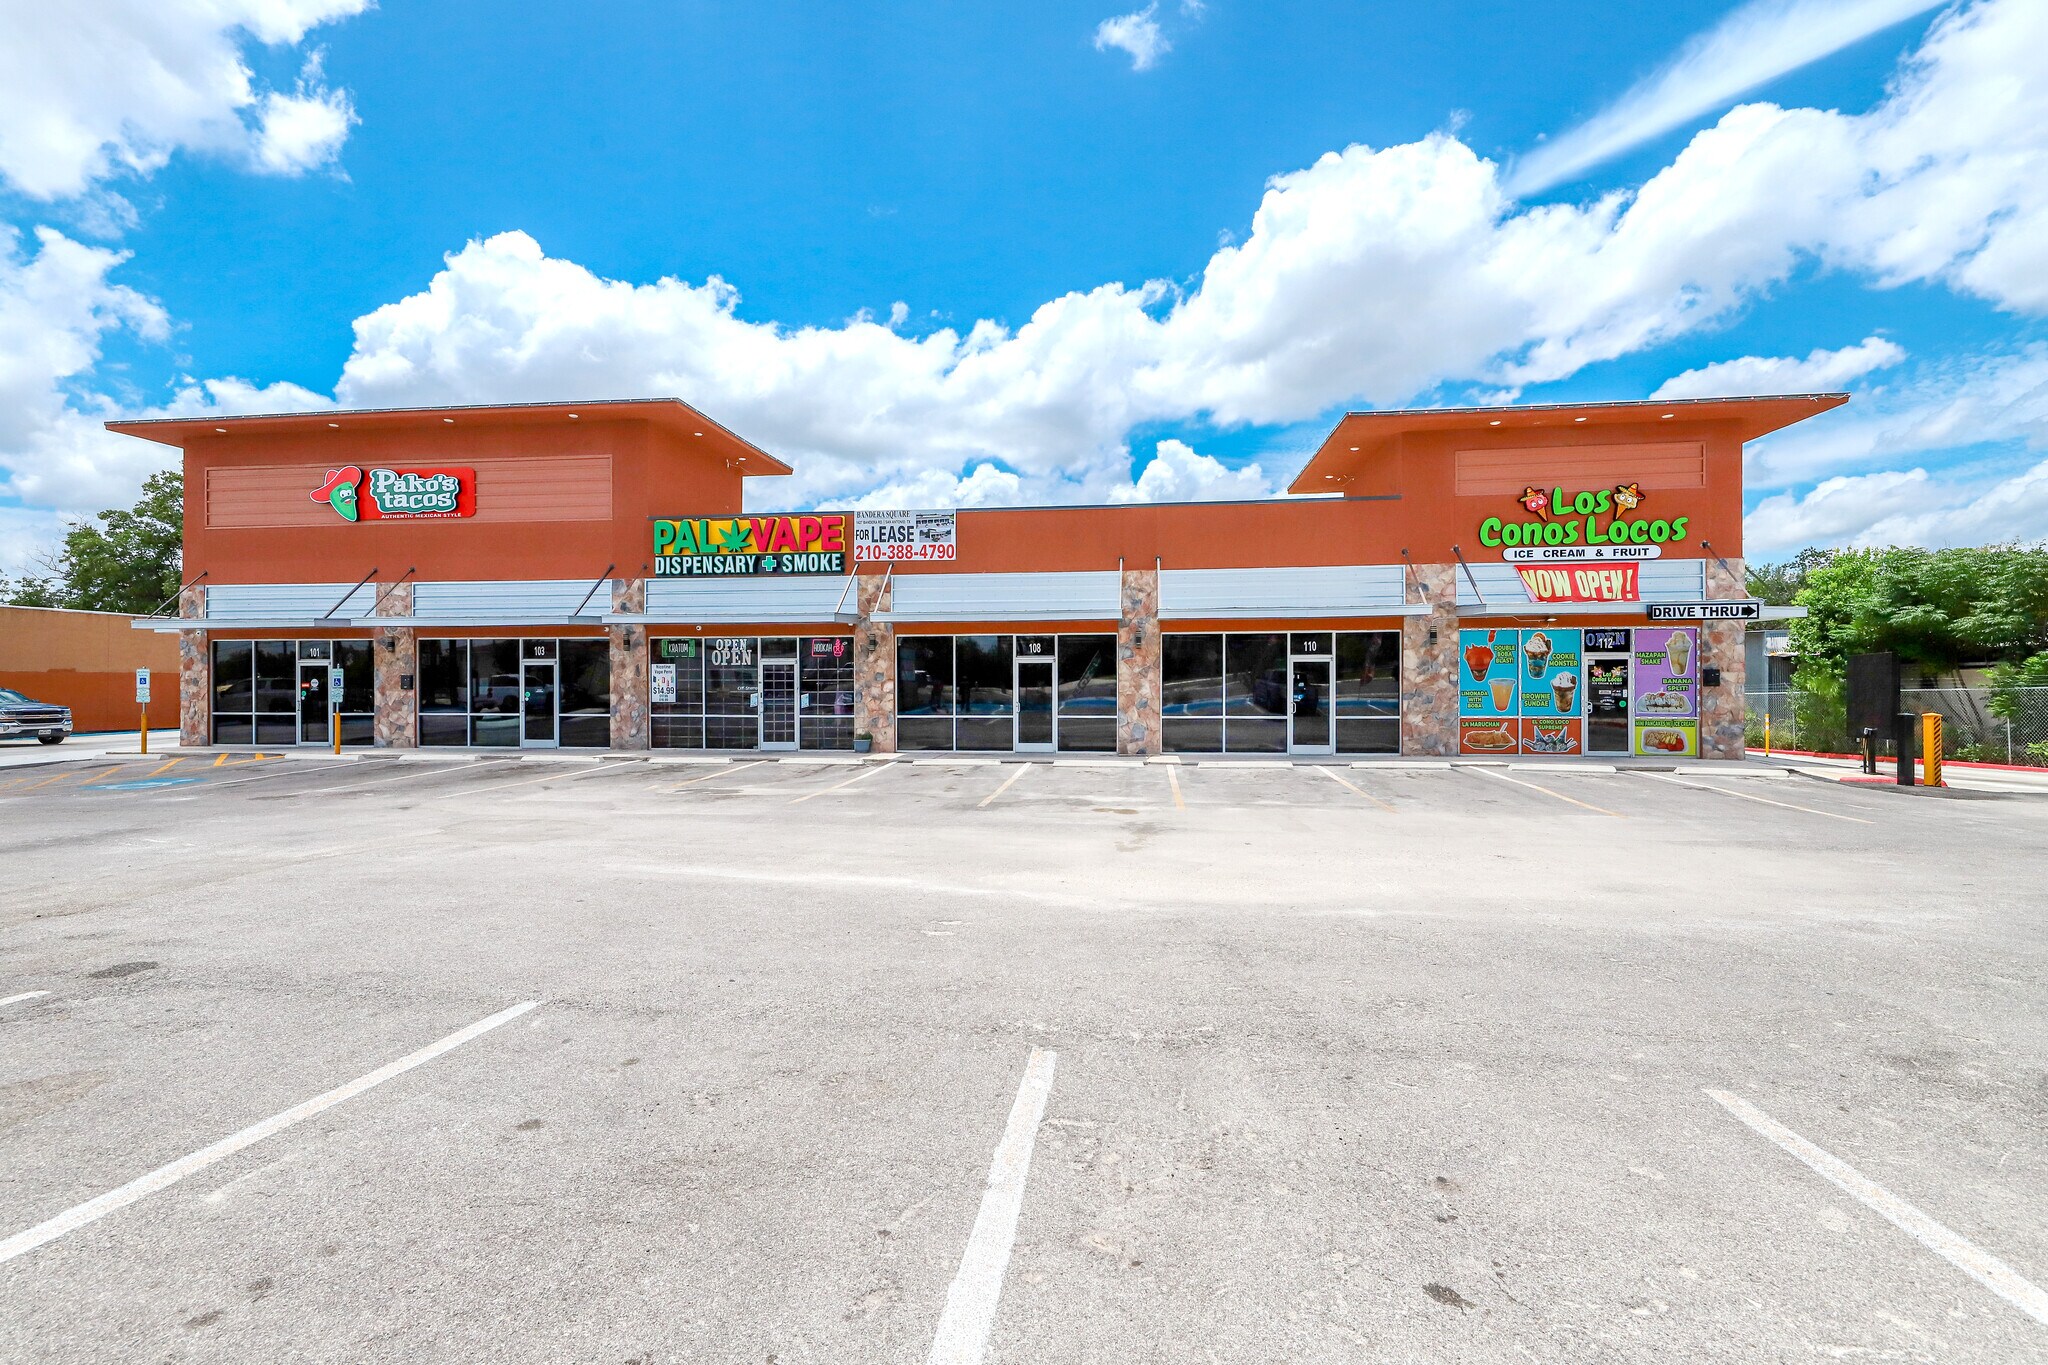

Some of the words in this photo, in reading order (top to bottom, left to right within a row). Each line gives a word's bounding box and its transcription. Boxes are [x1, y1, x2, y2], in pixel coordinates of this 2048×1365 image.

[376, 471, 455, 493] Pako's
[383, 492, 451, 509] tacos
[1552, 486, 1611, 516] Los
[856, 511, 886, 519] BANDERA
[886, 510, 911, 519] SQUARE
[653, 519, 720, 554] PAL
[750, 516, 844, 552] VAPE
[855, 529, 870, 541] FOR
[871, 525, 915, 543] LEASE
[1479, 517, 1580, 547] Conos
[1585, 515, 1689, 545] Locos
[855, 544, 955, 560] 210-388-4790
[1514, 549, 1534, 558] ICE
[1543, 548, 1586, 558] CREAM
[1595, 548, 1604, 557] &
[1613, 547, 1650, 557] FRUIT
[655, 555, 757, 575] DISPENSARY
[782, 553, 842, 573] SMOKE
[1574, 568, 1633, 600] OPEN!
[1653, 606, 1695, 618] DRIVE
[1700, 606, 1740, 617] THRU
[715, 638, 748, 651] OPEN
[1585, 631, 1626, 647] OPEN
[1599, 638, 1613, 649] 112
[310, 647, 320, 657] 101
[534, 646, 545, 656] 103
[668, 642, 689, 653] KRATOM
[814, 643, 832, 653] HOOKAH
[1029, 643, 1041, 653] 108
[1303, 641, 1317, 652] 110
[711, 649, 752, 666] OPEN
[652, 686, 675, 695] $14.99
